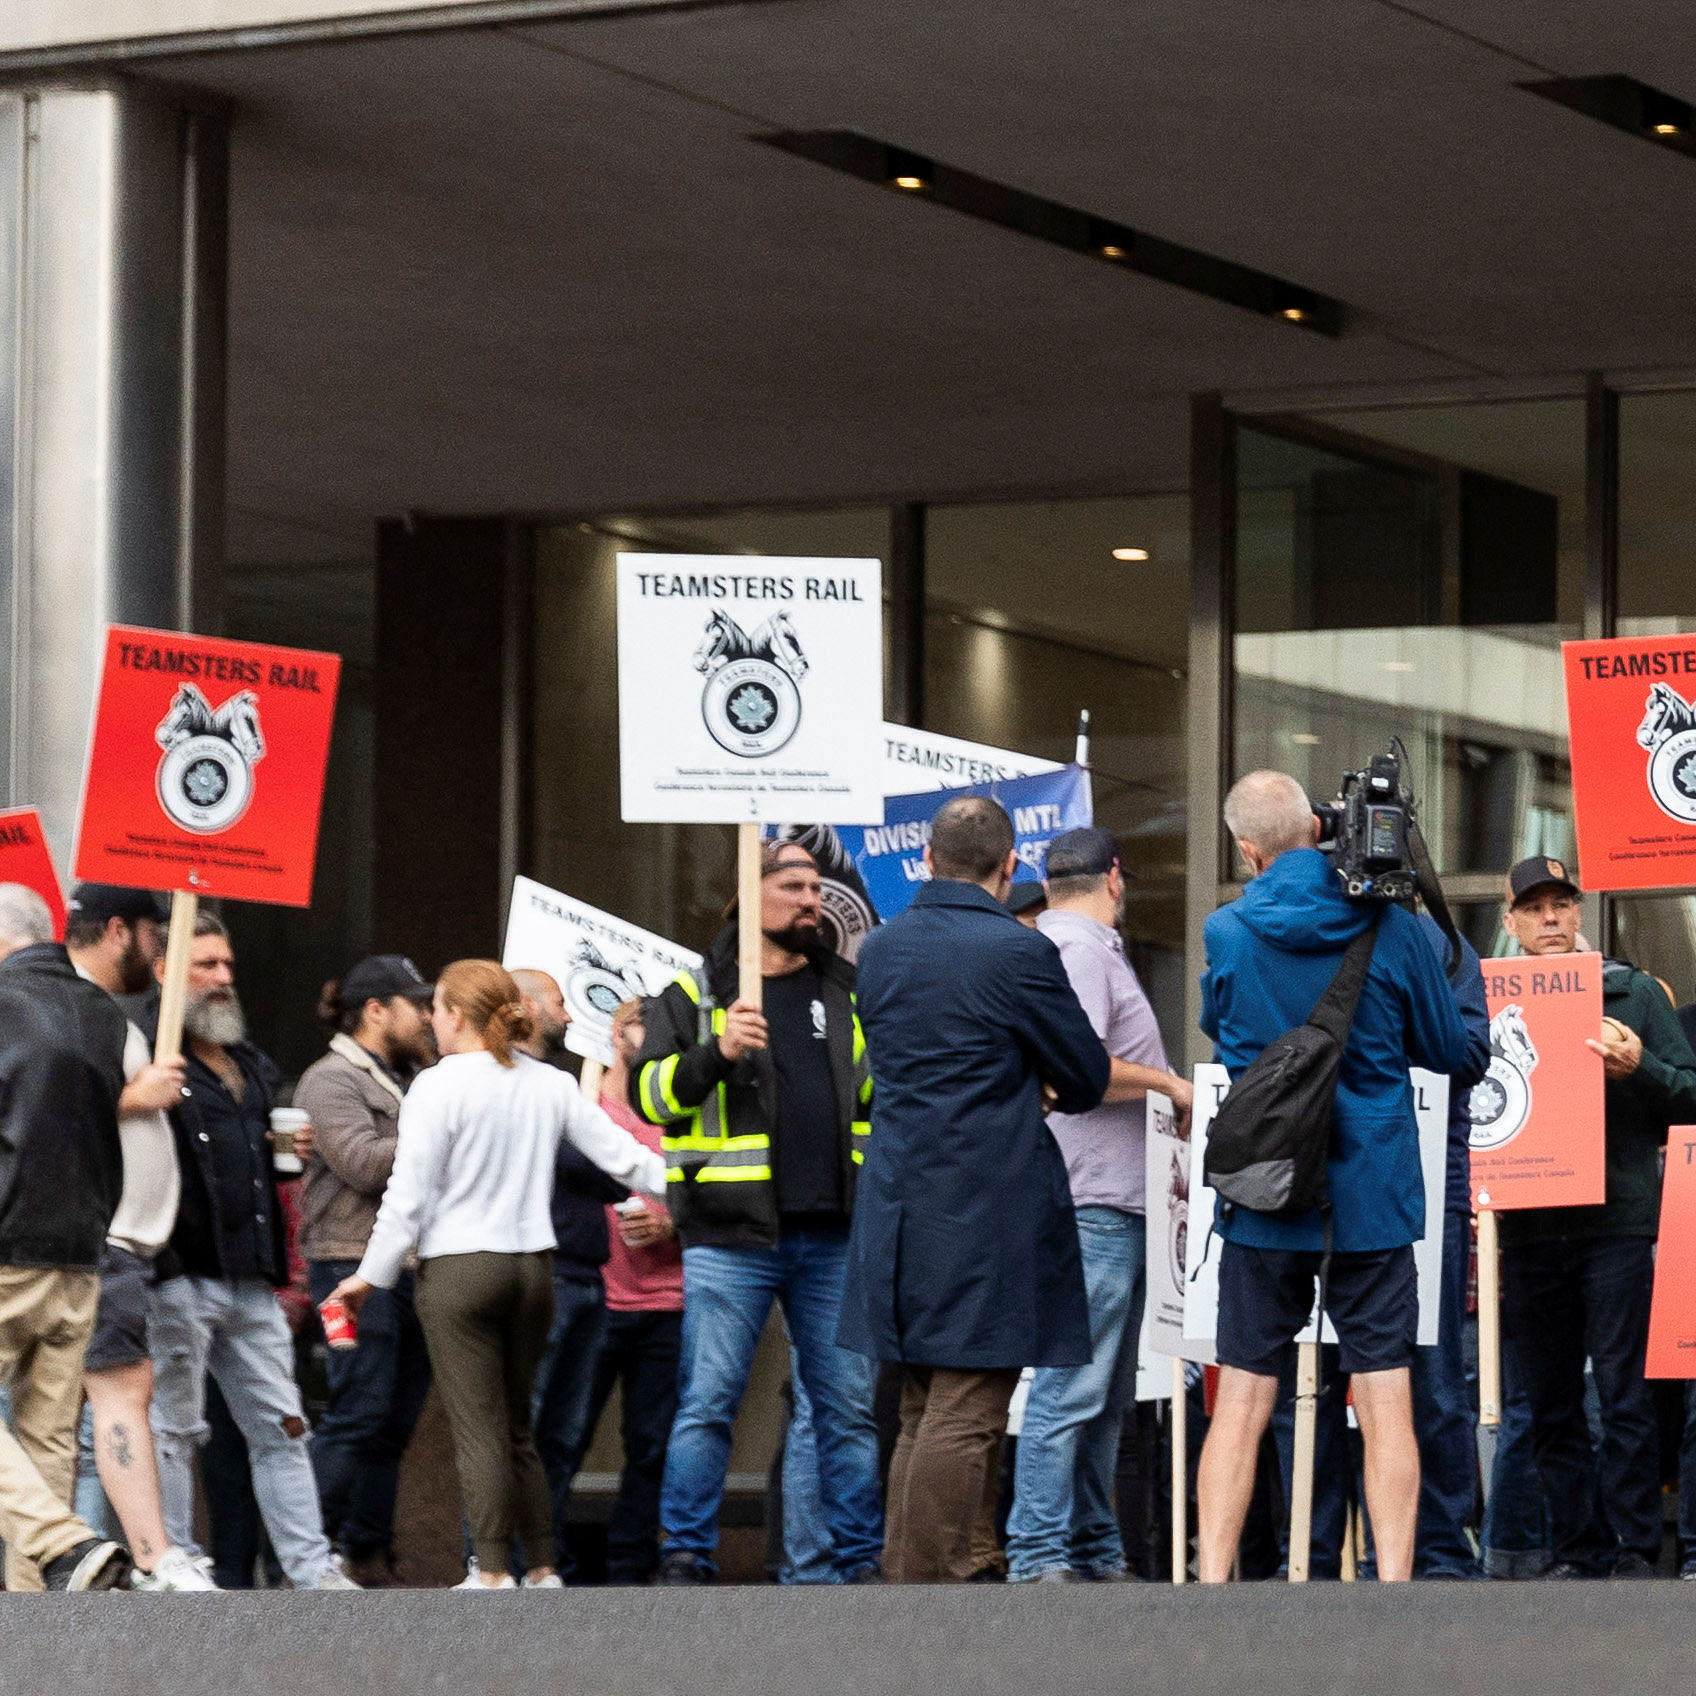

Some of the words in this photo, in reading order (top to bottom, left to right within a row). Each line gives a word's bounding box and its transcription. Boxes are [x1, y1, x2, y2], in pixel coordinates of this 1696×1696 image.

[637, 574, 794, 599] TEAMSTERS
[806, 577, 862, 601] RAIL
[119, 642, 261, 685] TEAMSTERS
[269, 664, 321, 693] RAIL
[1533, 971, 1586, 995] RAIL
